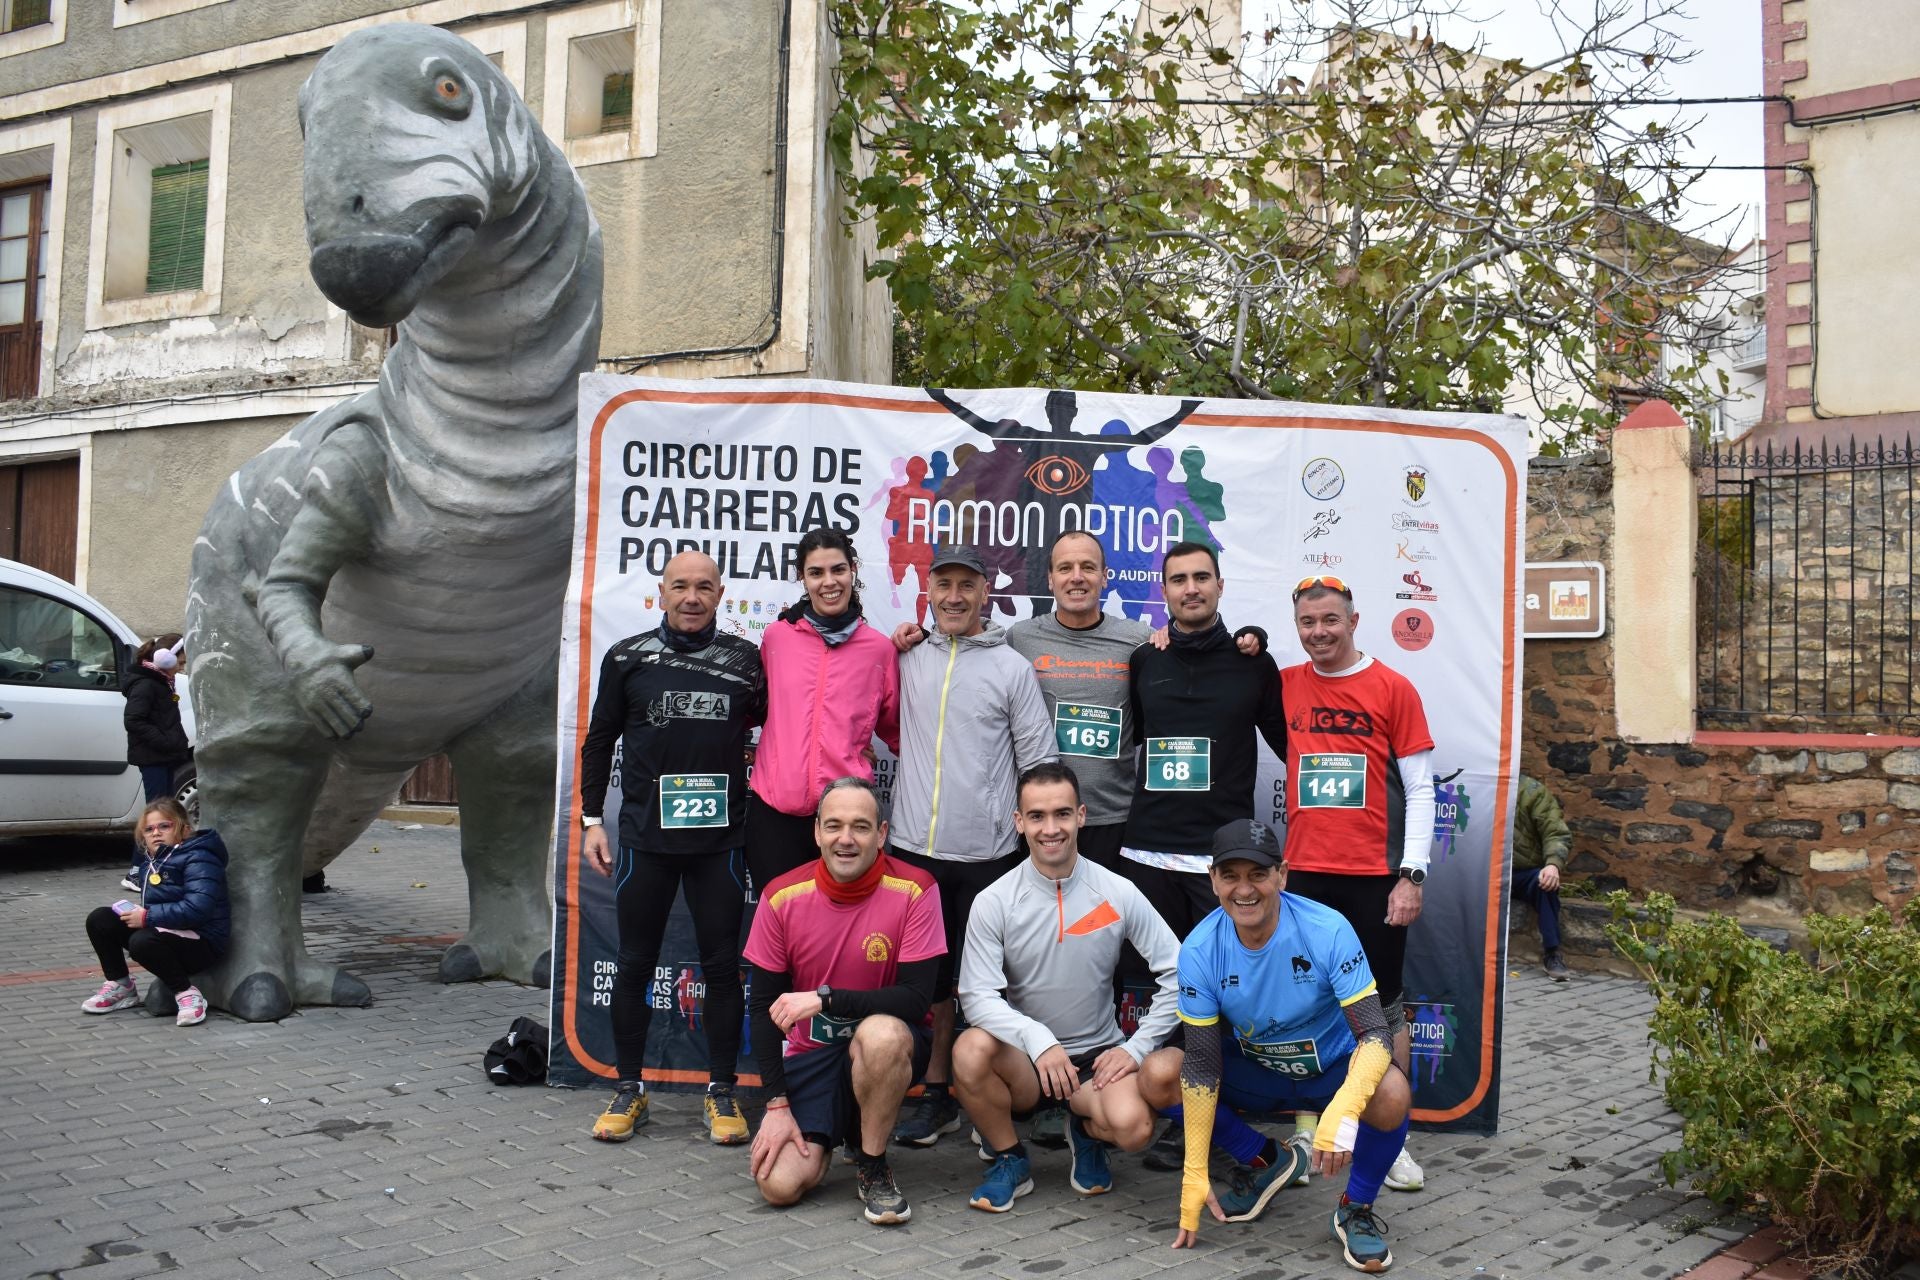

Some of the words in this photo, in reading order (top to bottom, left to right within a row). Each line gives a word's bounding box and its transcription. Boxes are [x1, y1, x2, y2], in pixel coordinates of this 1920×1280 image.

[622, 440, 798, 482] CIRCUITO
[812, 446, 862, 485] DE
[1307, 462, 1326, 479] RINCON
[1317, 475, 1340, 496] ATLETISMO
[620, 485, 861, 535] CARRERAS
[907, 497, 1045, 547] RAMON
[1059, 502, 1184, 554] OPTICA
[1394, 630, 1433, 639] ANDOSILLA
[1066, 726, 1110, 748] 165
[1162, 761, 1190, 780] 68
[1308, 777, 1350, 797] 141
[672, 798, 717, 818] 223
[655, 966, 672, 980] DE
[1257, 1057, 1309, 1075] 236
